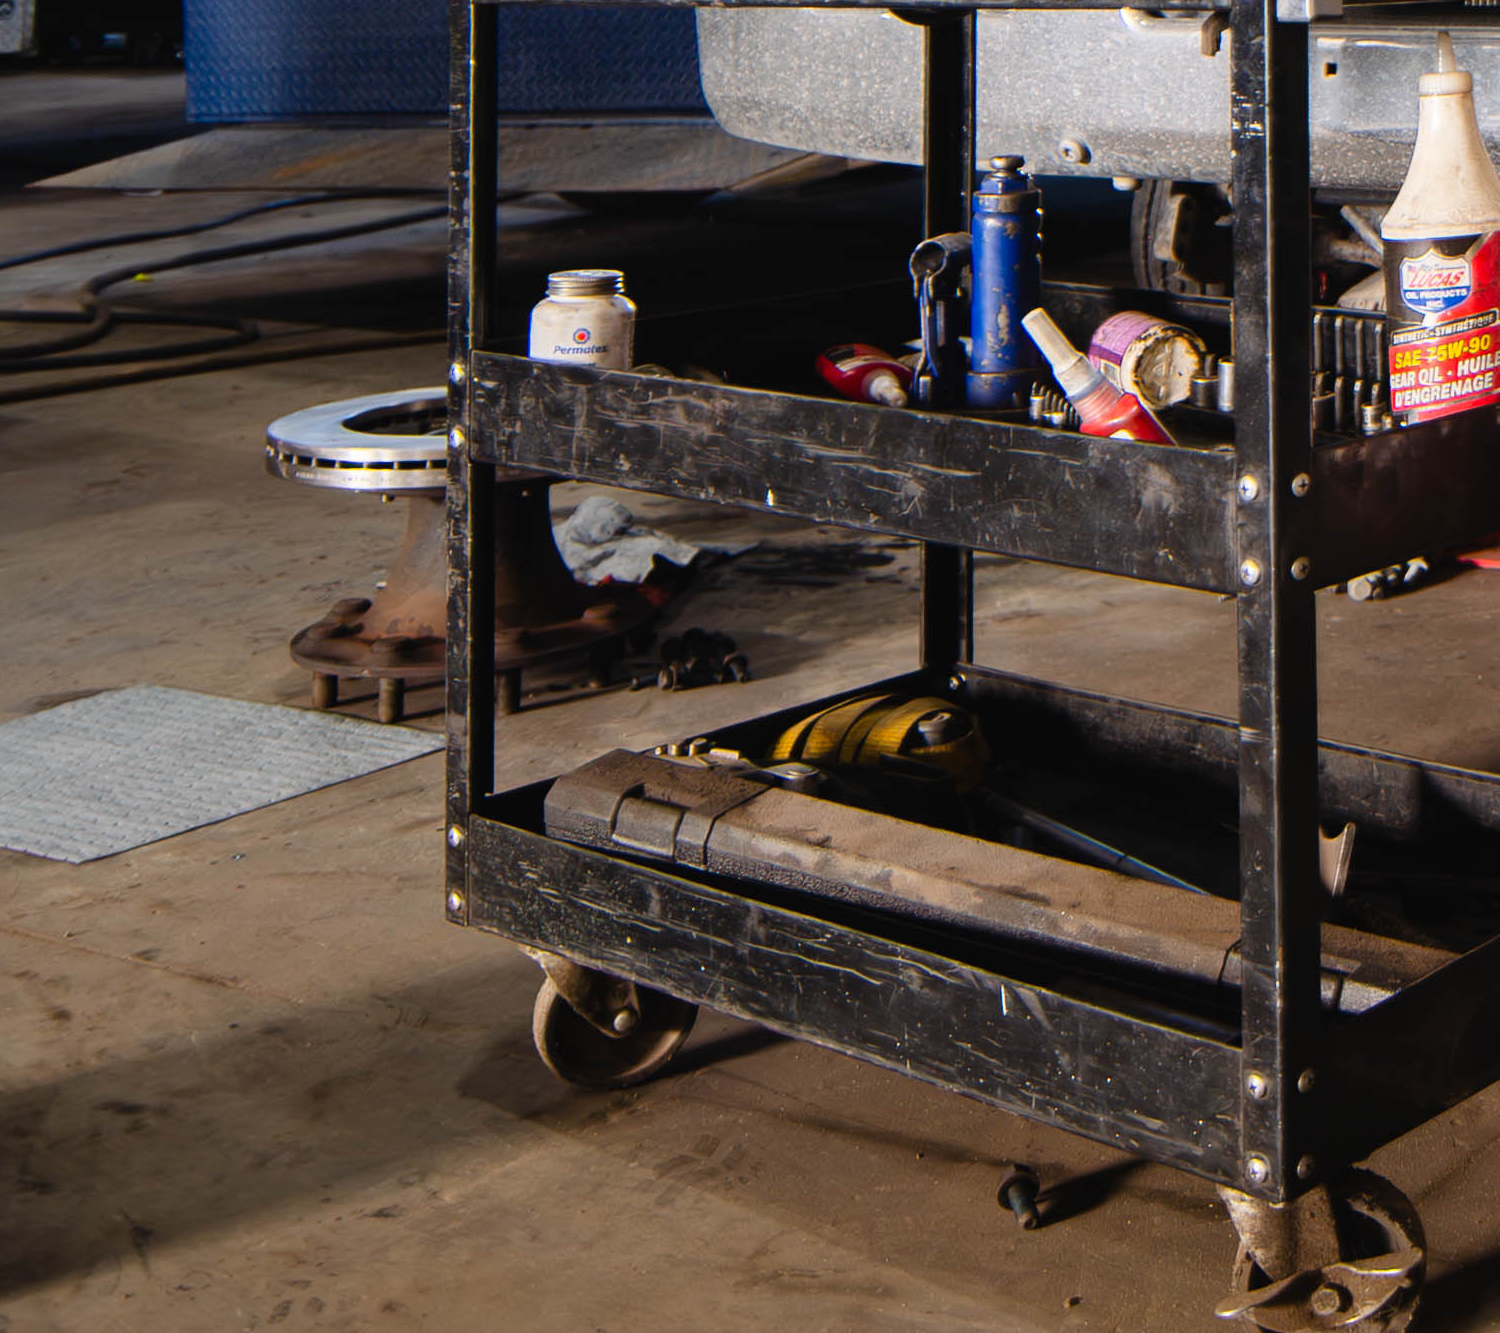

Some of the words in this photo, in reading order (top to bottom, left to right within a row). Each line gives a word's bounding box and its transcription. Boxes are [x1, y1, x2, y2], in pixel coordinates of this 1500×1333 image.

[1407, 270, 1465, 289] LUCAS
[1405, 291, 1419, 301] OIL
[1419, 288, 1468, 300] PRODUCTS
[553, 343, 609, 355] Permatex
[1395, 348, 1422, 369] SAE
[1418, 366, 1443, 386] OIL
[1394, 371, 1494, 408] D'ENGRENAGE
